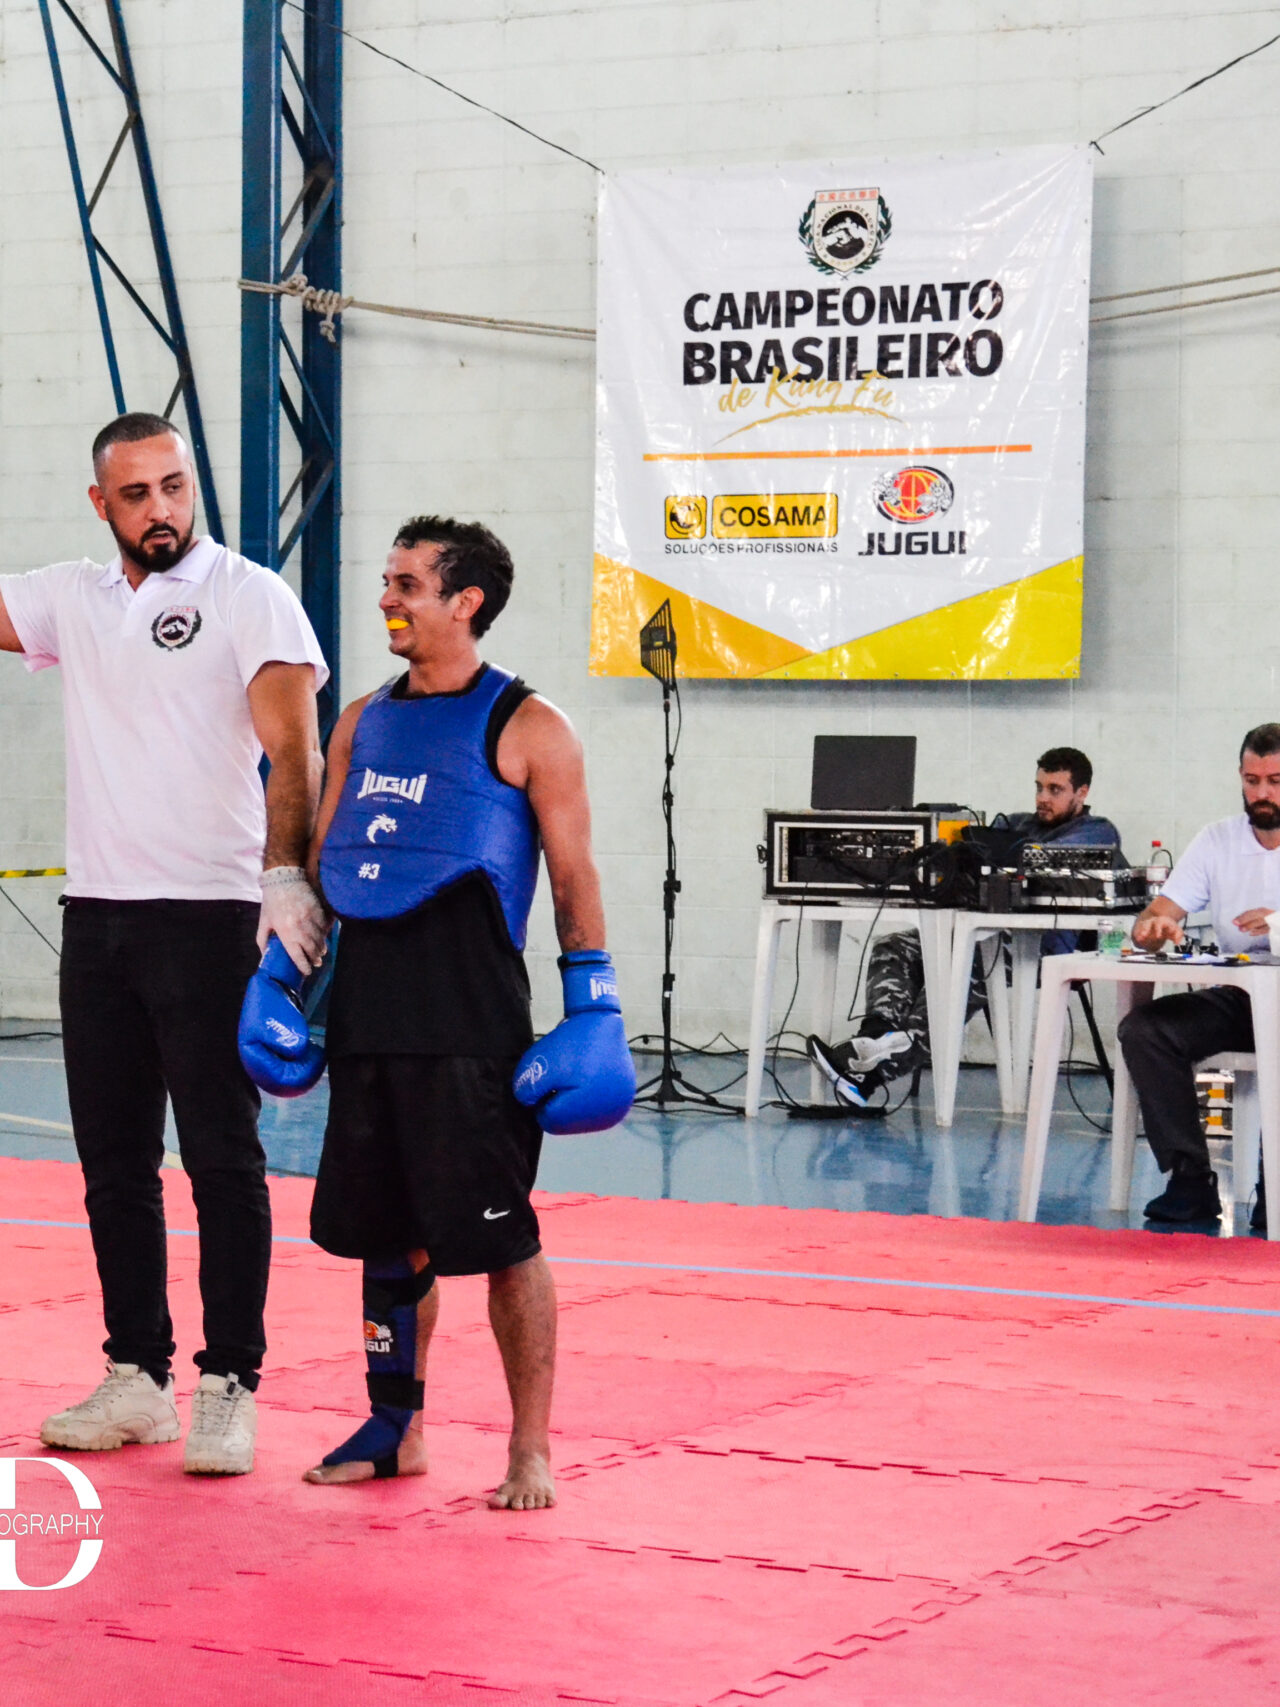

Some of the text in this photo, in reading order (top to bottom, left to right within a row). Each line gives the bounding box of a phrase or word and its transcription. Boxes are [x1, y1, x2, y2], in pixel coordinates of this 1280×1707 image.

[684, 279, 1004, 332] CAMPEONATO
[683, 329, 1004, 385] BRASILEIRO
[718, 364, 894, 413] de Kung Fu
[720, 505, 827, 528] COSAMA
[858, 530, 967, 556] JUGUI
[357, 767, 428, 805] JUGUI
[358, 862, 381, 880] #3
